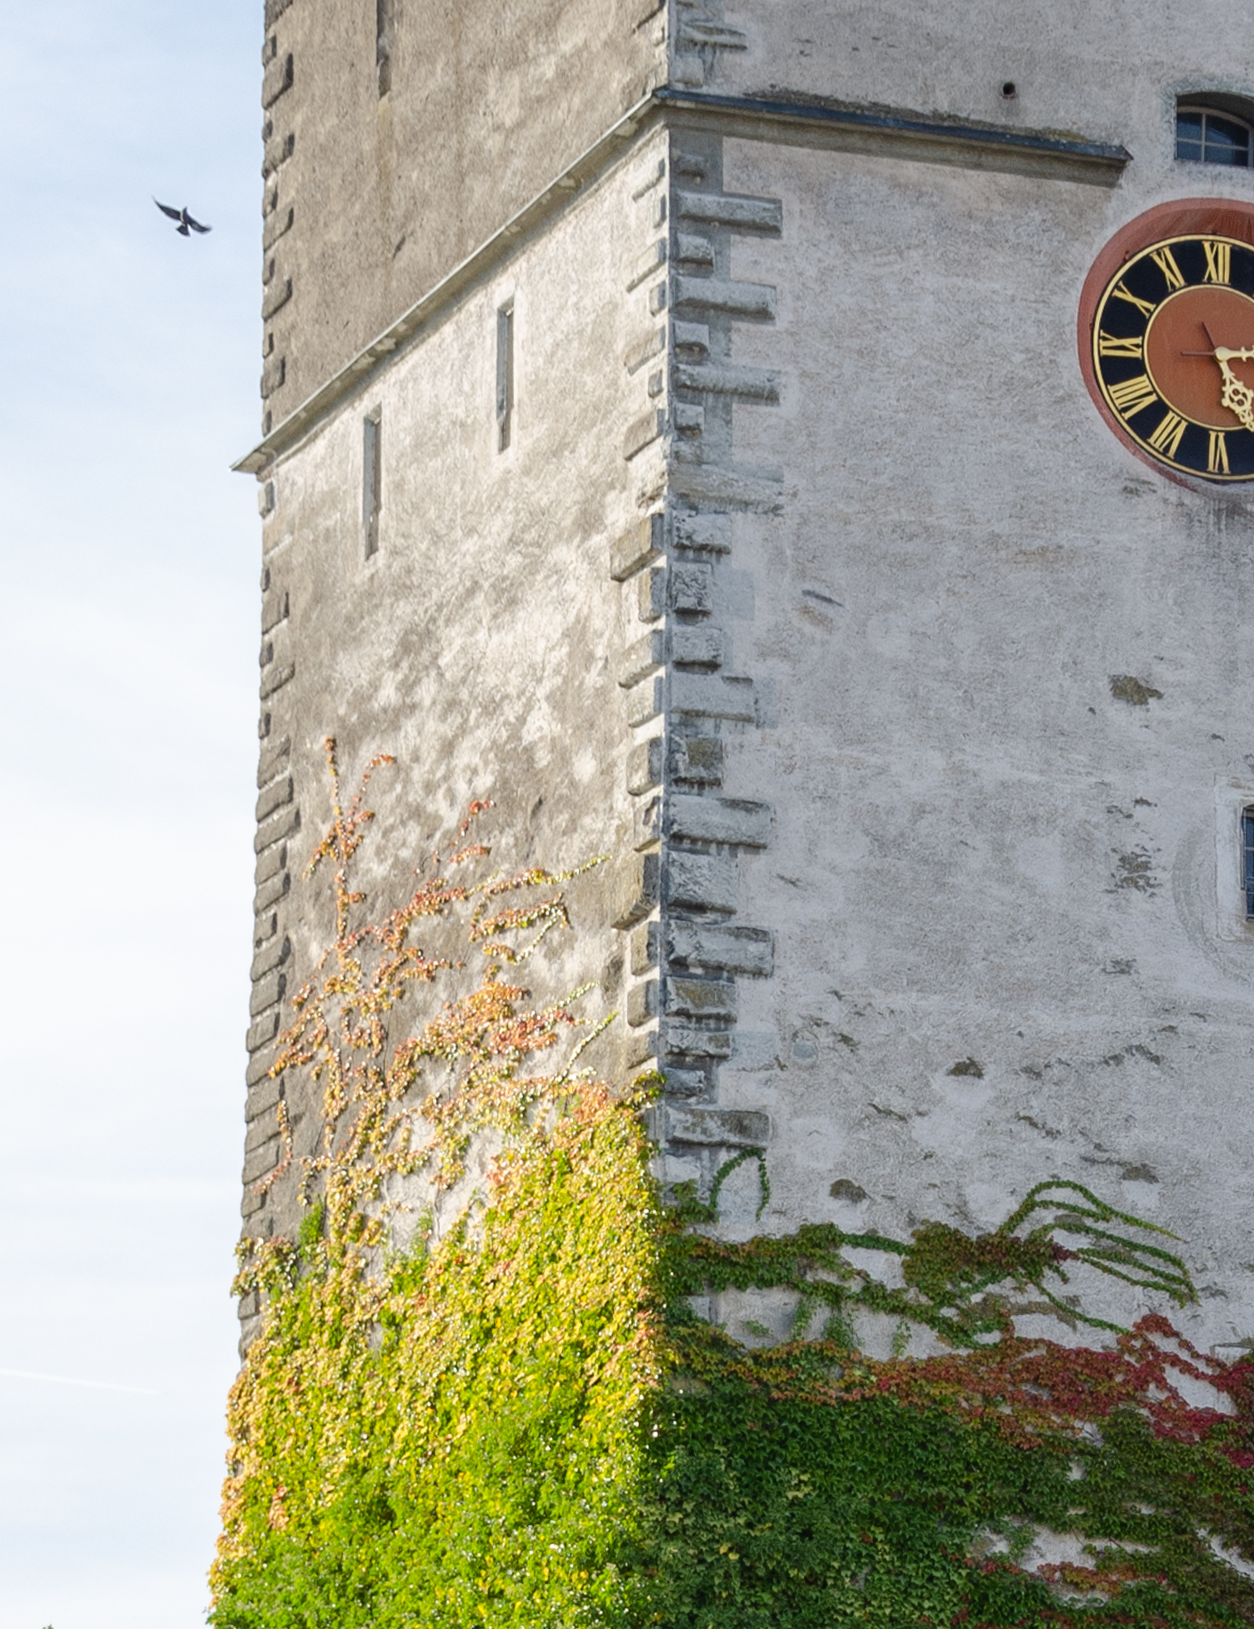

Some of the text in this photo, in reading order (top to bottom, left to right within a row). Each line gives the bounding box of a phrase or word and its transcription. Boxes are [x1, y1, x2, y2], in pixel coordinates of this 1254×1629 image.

[1150, 246, 1188, 292] XI
[1202, 241, 1232, 285] XII
[1112, 281, 1156, 319] X
[1099, 330, 1142, 359] IX
[1108, 374, 1158, 420] VIII
[1147, 411, 1188, 459] VII
[1207, 431, 1231, 474] VI
